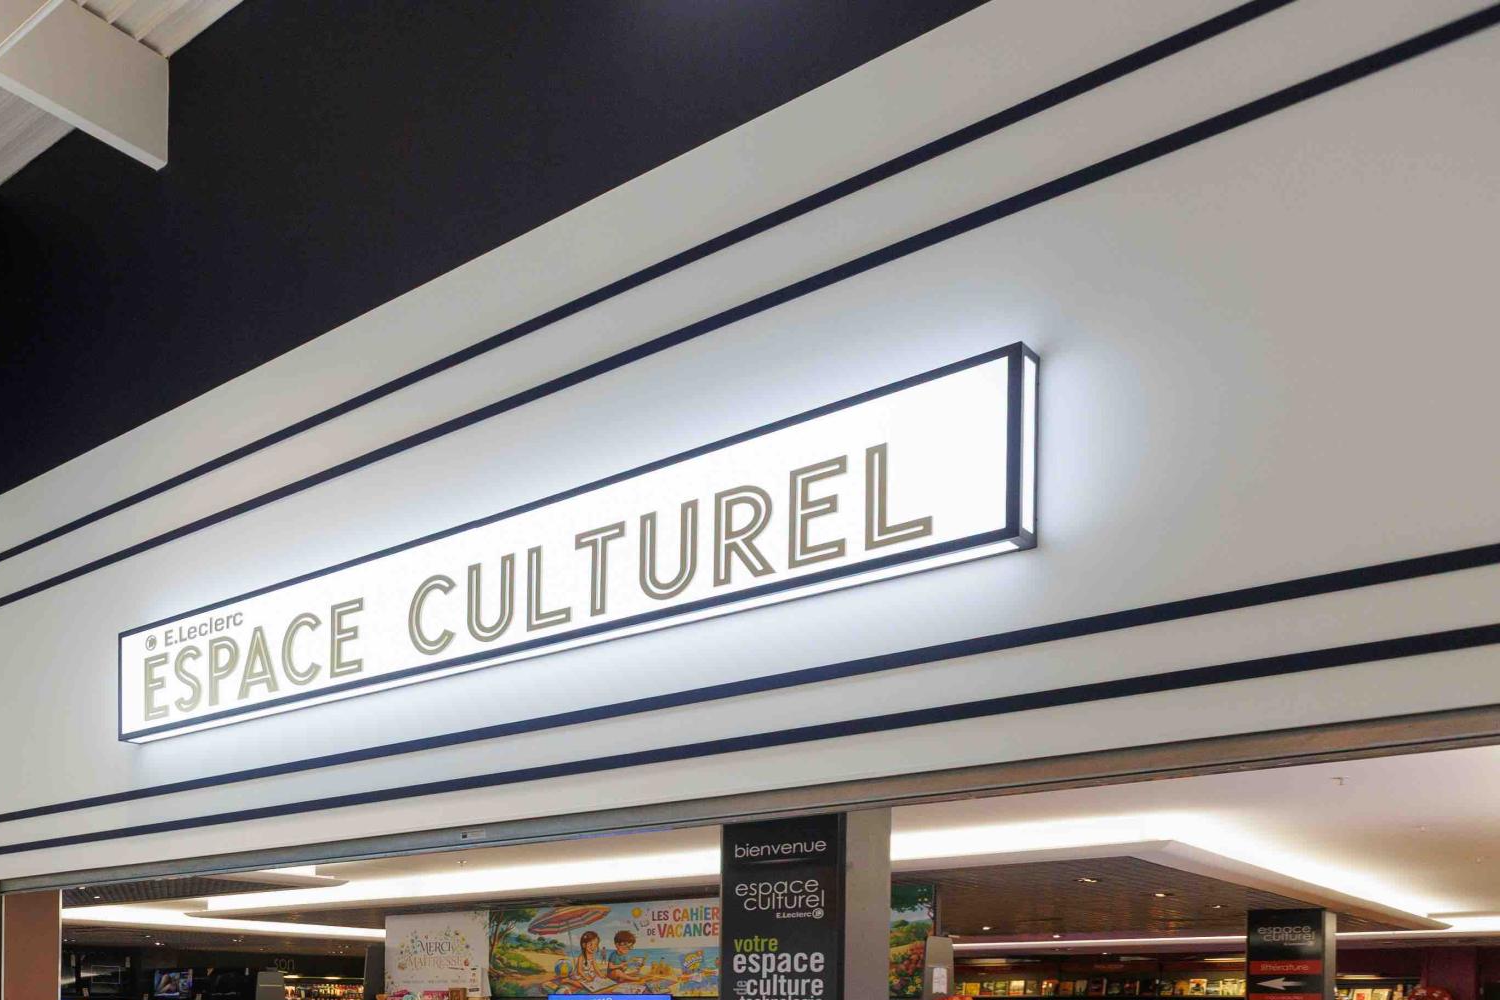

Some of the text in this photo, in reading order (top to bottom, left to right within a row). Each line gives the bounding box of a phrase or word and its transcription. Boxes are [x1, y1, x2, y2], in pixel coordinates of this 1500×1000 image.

[144, 442, 934, 722] ESPACE CULTUREL
[164, 611, 244, 648] E.Leclerc
[734, 840, 827, 859] bienvenue
[735, 879, 820, 897] espace
[743, 889, 825, 911] culturel
[651, 910, 669, 922] LES
[775, 911, 812, 919] E.Leclerc
[646, 928, 656, 937] DE
[1257, 925, 1312, 938] espace
[1263, 931, 1316, 943] culturel
[419, 940, 452, 956] MERCI
[734, 935, 779, 953] votre
[733, 951, 825, 979] espace
[1260, 963, 1310, 973] littérature
[746, 974, 824, 997] culture
